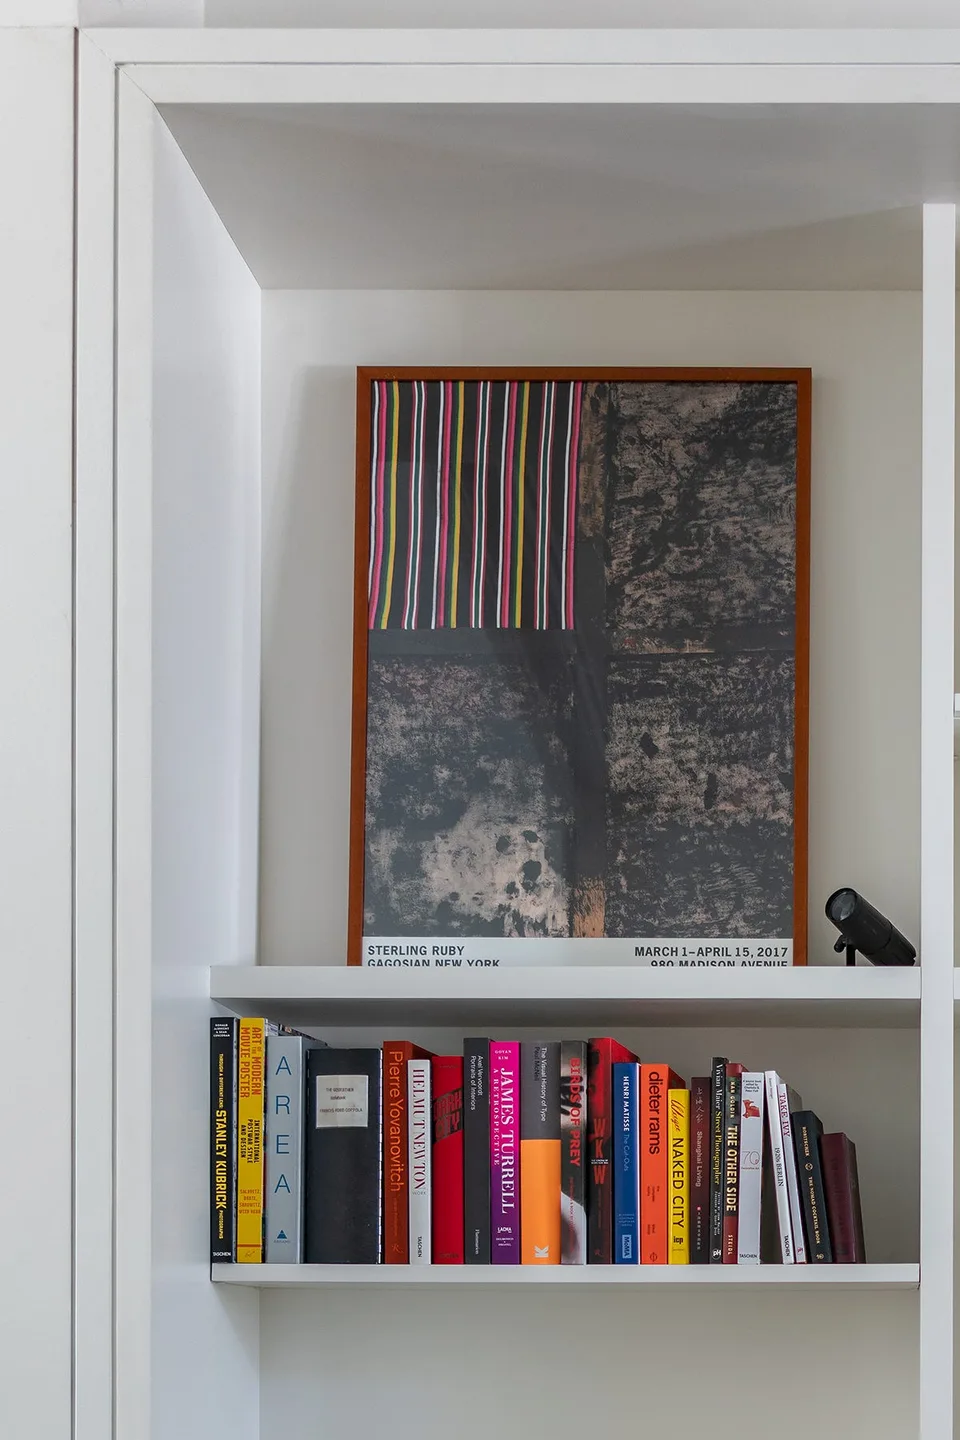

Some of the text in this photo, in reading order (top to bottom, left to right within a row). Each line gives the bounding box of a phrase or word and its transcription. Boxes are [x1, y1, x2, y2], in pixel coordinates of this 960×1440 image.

[368, 946, 465, 956] STERLING RUBY
[634, 947, 678, 957] MARCH
[735, 947, 754, 959] 15,
[757, 947, 788, 957] 2017
[252, 1027, 262, 1044] ART
[240, 1027, 250, 1098] MOVIE POSTER
[252, 1056, 262, 1095] MODERN
[570, 1058, 581, 1103] BIRDS
[715, 1064, 723, 1087] Vivian
[570, 1107, 581, 1126] OF
[648, 1071, 664, 1155] dieter rams
[715, 1088, 723, 1109] Maier
[779, 1092, 791, 1137] TAKE IVY
[216, 1110, 227, 1157] STANLEY
[273, 1056, 291, 1194] AREA
[389, 1051, 404, 1191] Pierre Yovanovitch
[413, 1069, 426, 1190] HELMUT NEWTON
[727, 1126, 737, 1146] THE
[500, 1068, 515, 1214] JAMES TURRELL
[570, 1131, 581, 1167] PREY
[694, 1131, 703, 1163] Shanghai
[673, 1137, 685, 1190] NAKED
[694, 1165, 703, 1187] Living
[713, 1135, 722, 1184] Photographer
[727, 1149, 737, 1184] OTHER
[774, 1147, 784, 1187] 1920s BERLIN
[216, 1160, 227, 1209] KUBRICK
[727, 1186, 737, 1212] SIDE
[673, 1195, 685, 1228] CITY
[811, 1206, 819, 1229] COCKTAIL
[783, 1235, 791, 1257] TASCHEN
